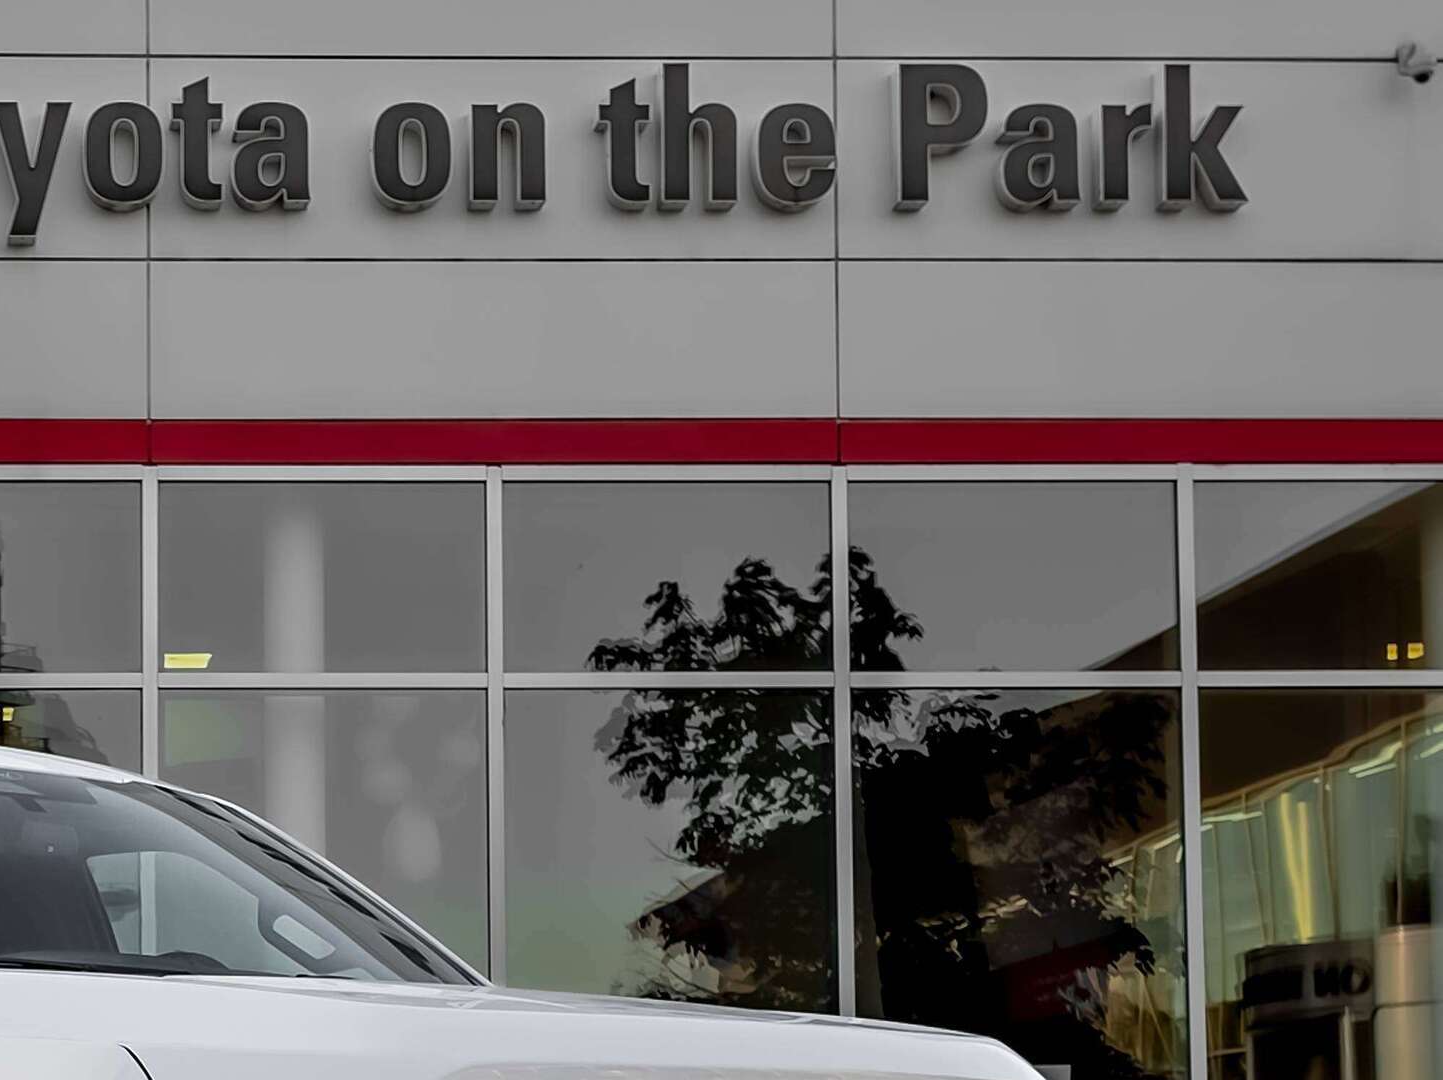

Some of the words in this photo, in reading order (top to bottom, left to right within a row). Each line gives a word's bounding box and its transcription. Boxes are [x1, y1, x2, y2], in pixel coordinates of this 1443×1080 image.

[371, 101, 546, 212] on
[595, 62, 837, 212] the
[892, 63, 1249, 212] Park
